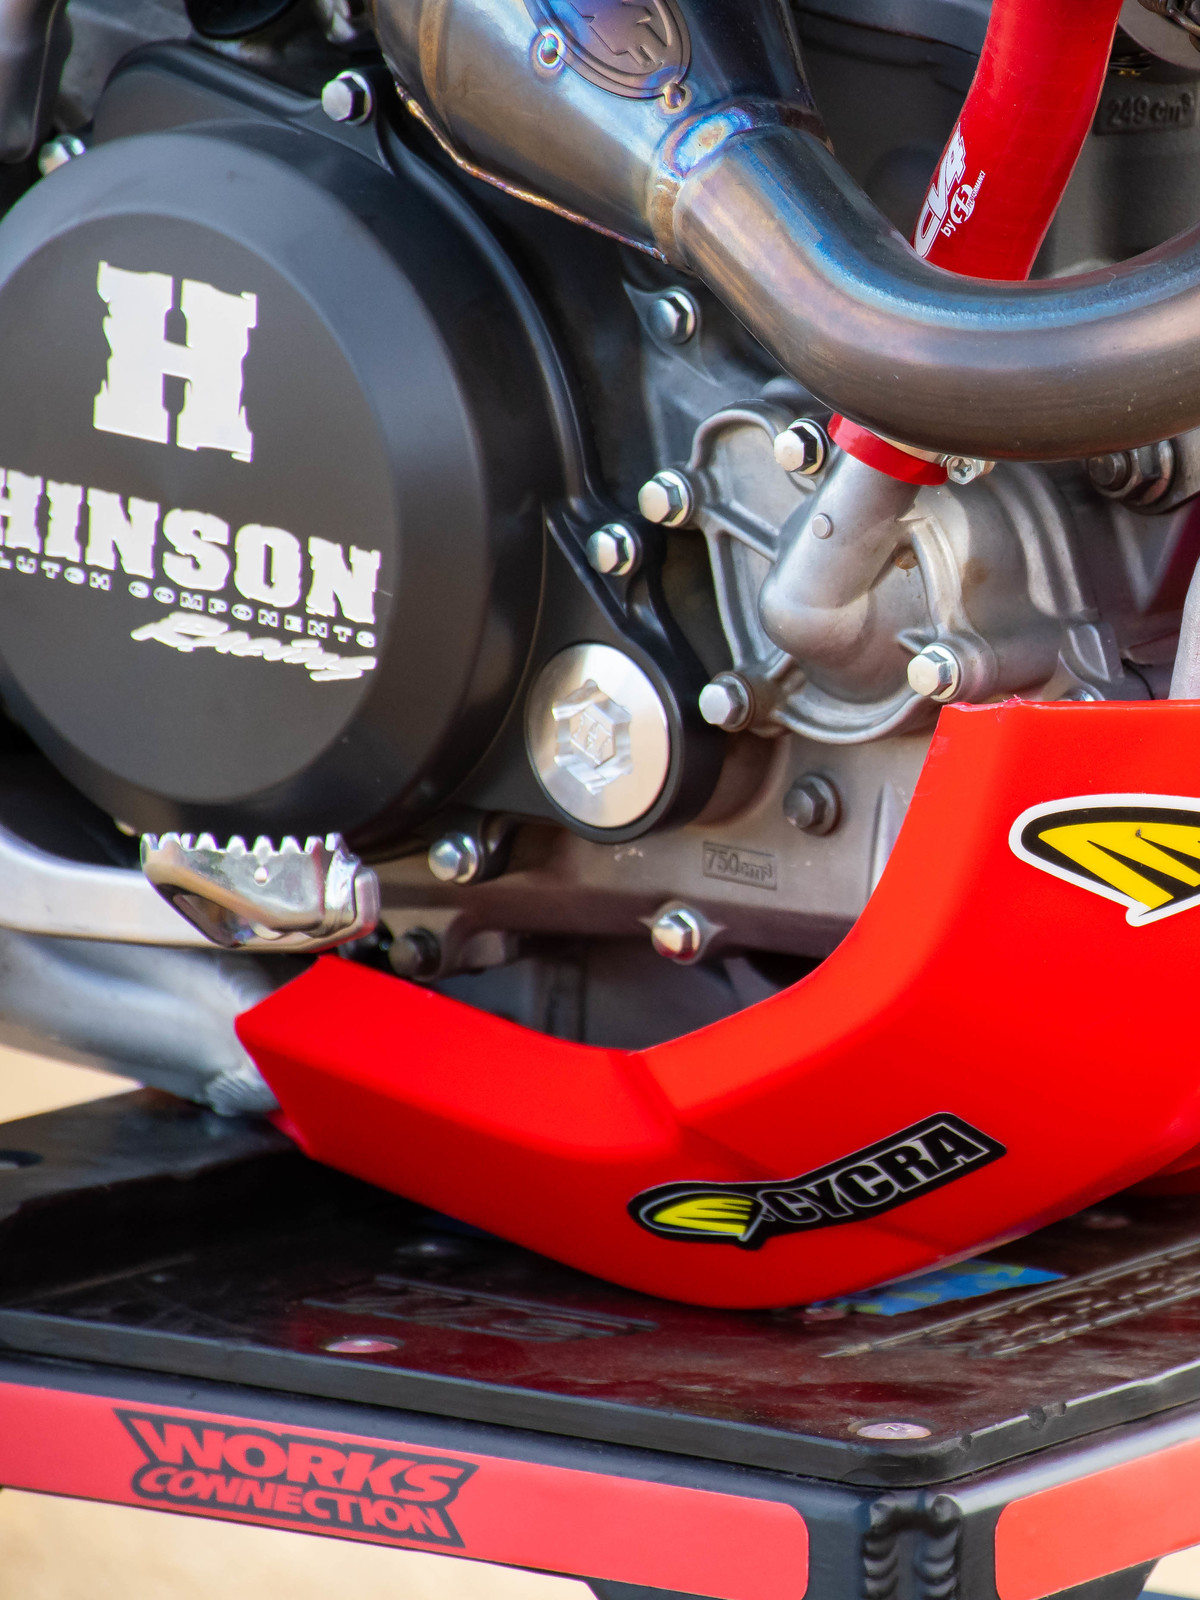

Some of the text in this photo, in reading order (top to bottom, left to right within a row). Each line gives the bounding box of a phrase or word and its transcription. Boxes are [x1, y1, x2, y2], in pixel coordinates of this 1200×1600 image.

[914, 122, 966, 258] CV4
[941, 218, 957, 238] by
[93, 260, 257, 463] H
[0, 468, 381, 624] HINSON
[128, 580, 377, 648] COMPONENTS
[757, 1122, 990, 1224] CYCRA
[128, 1416, 465, 1502] WORKS
[138, 1465, 451, 1539] CONNECTION
